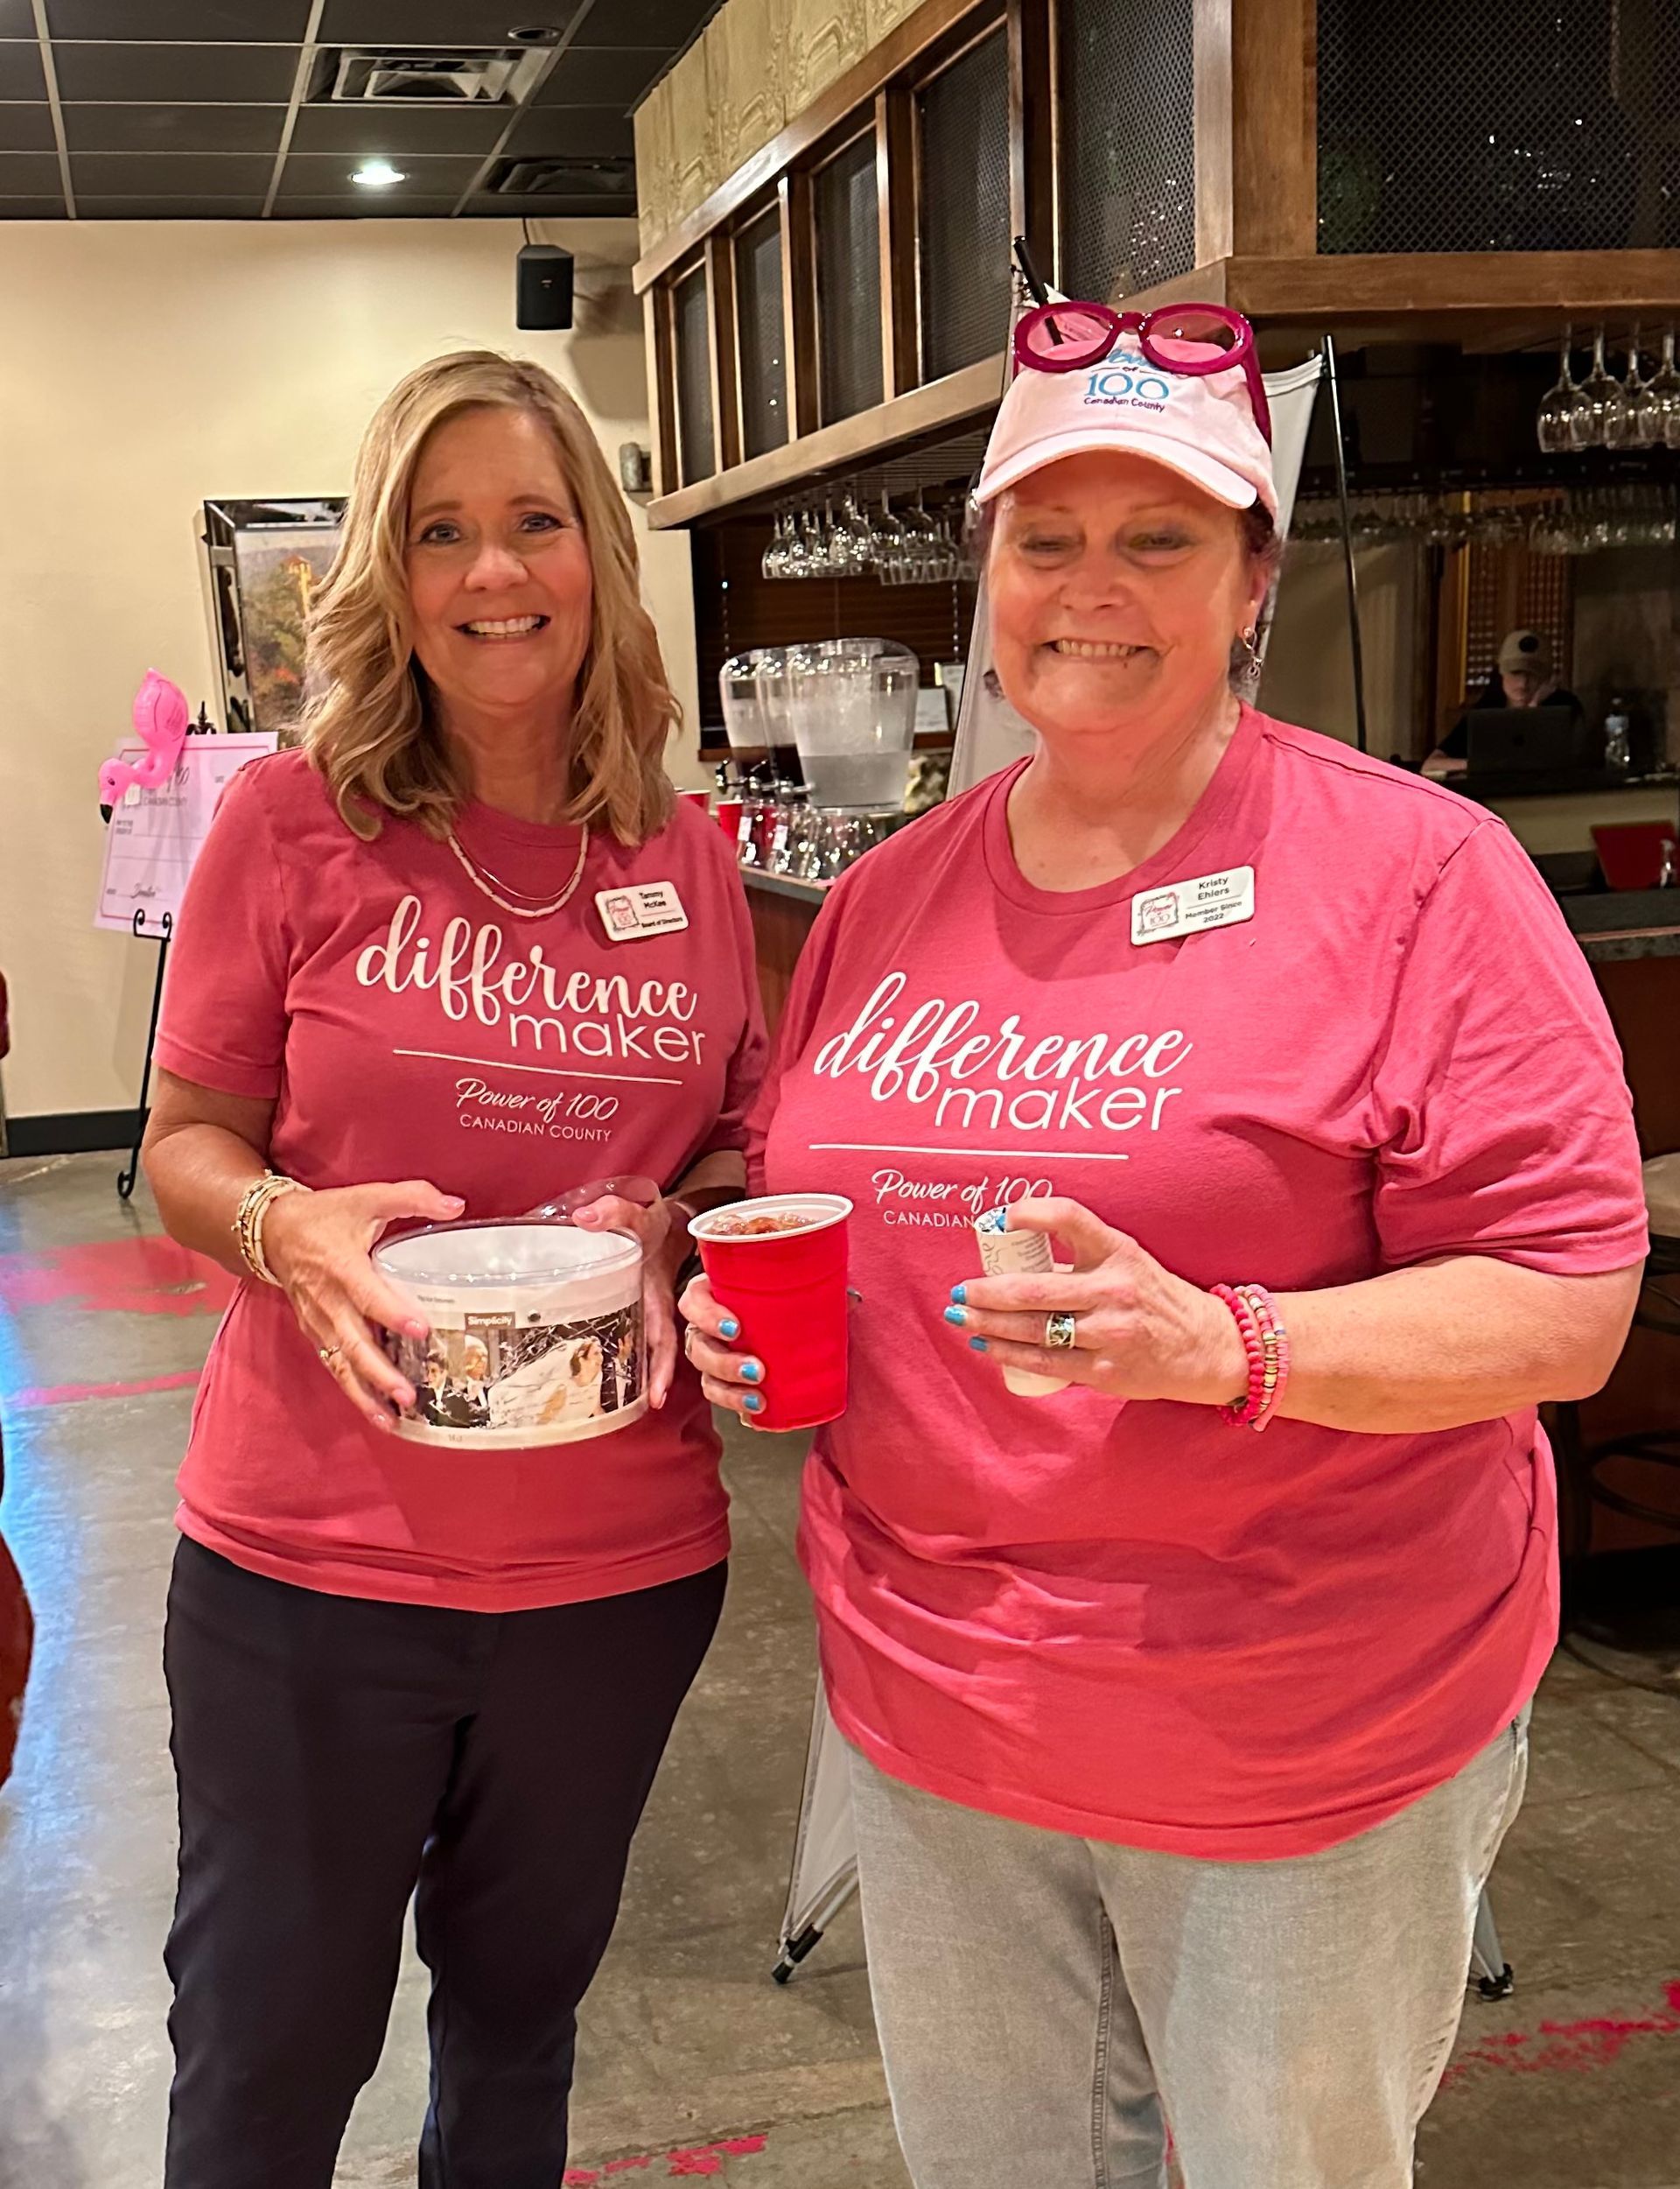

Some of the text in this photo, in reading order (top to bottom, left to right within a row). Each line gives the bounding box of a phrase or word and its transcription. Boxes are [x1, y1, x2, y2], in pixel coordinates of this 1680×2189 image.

[1084, 372, 1169, 400] 100
[1083, 396, 1166, 413] Canadian County
[1198, 888, 1229, 900] Ehlers
[1199, 876, 1228, 889] Kristy
[1186, 907, 1218, 919] Member
[1221, 901, 1242, 911] Since
[1203, 913, 1224, 923] 2022
[355, 895, 697, 1026] difference
[509, 1013, 705, 1065] maker
[813, 972, 1193, 1103] difference
[455, 1077, 619, 1123] Power of 100
[934, 1077, 1182, 1131] maker
[459, 1114, 612, 1141] CANADIAN COUNTY
[872, 1168, 1054, 1214] Power of 100
[884, 1210, 975, 1228] CANADIAN
[467, 1316, 513, 1327] Simplicity
